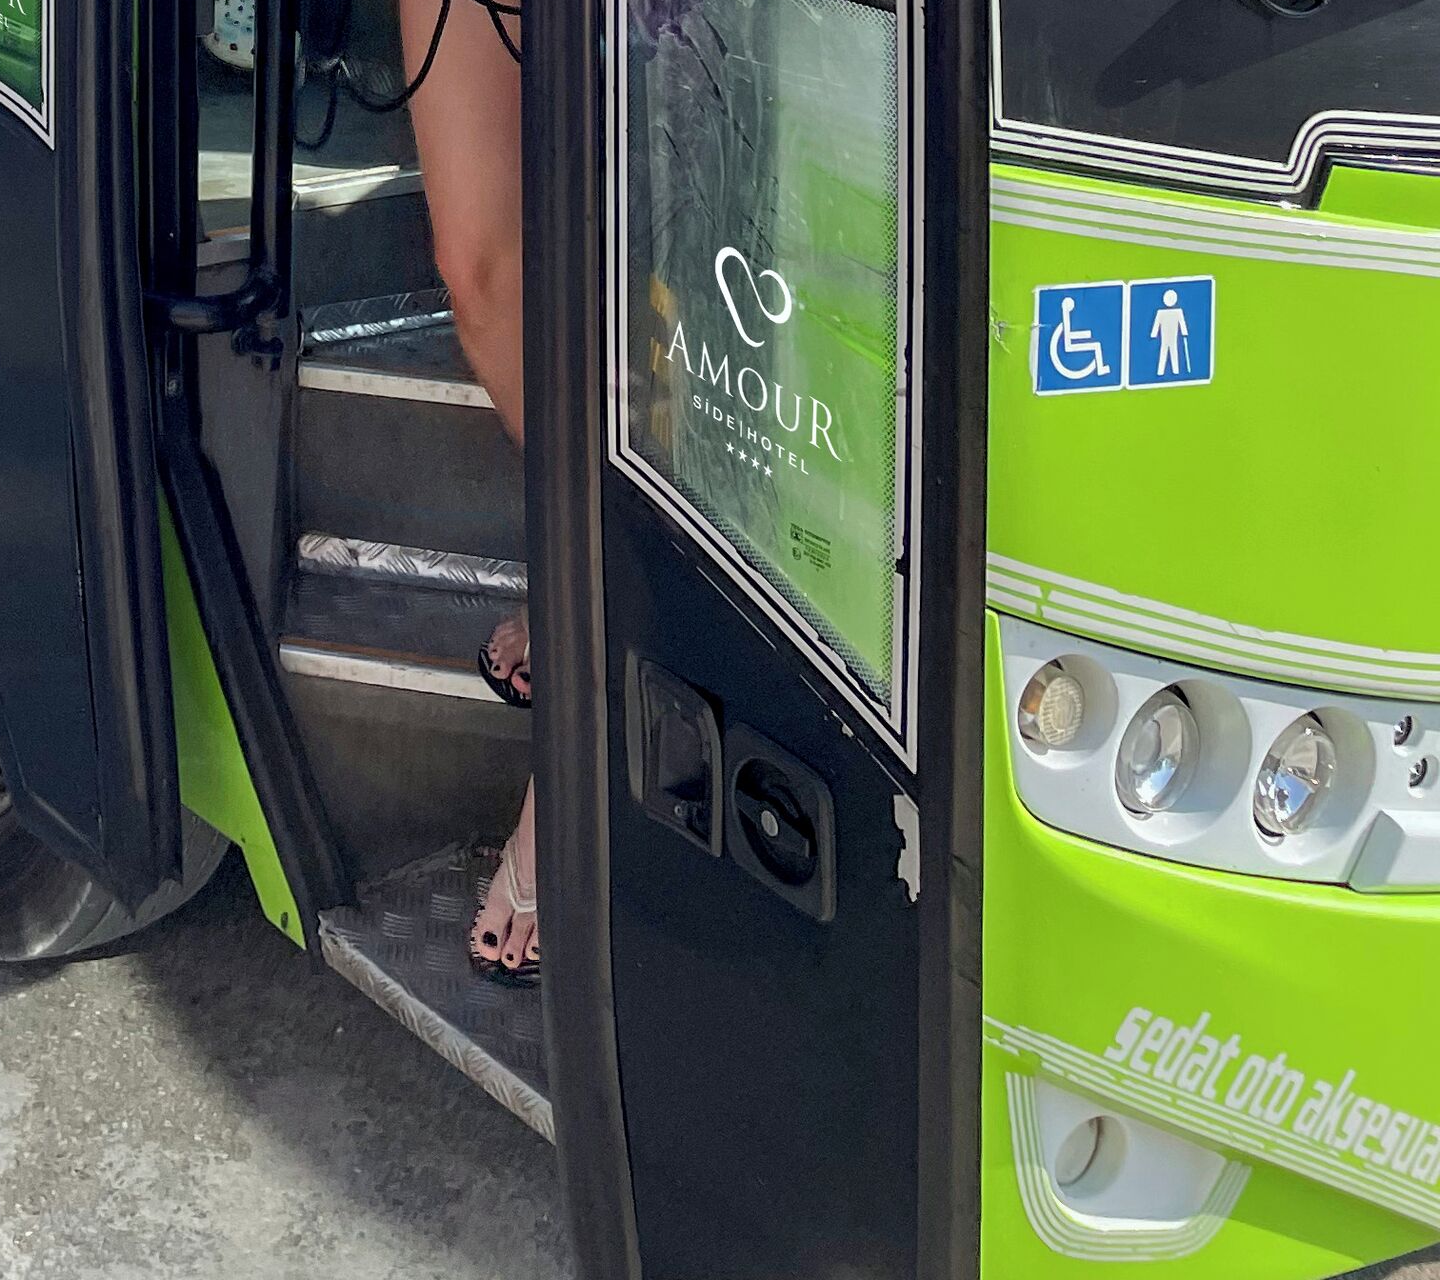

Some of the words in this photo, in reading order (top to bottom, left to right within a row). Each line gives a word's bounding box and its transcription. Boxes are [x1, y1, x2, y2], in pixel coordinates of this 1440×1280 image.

[664, 321, 843, 462] AMOUR
[1104, 1006, 1242, 1100] sedat
[1224, 1051, 1306, 1126] oto
